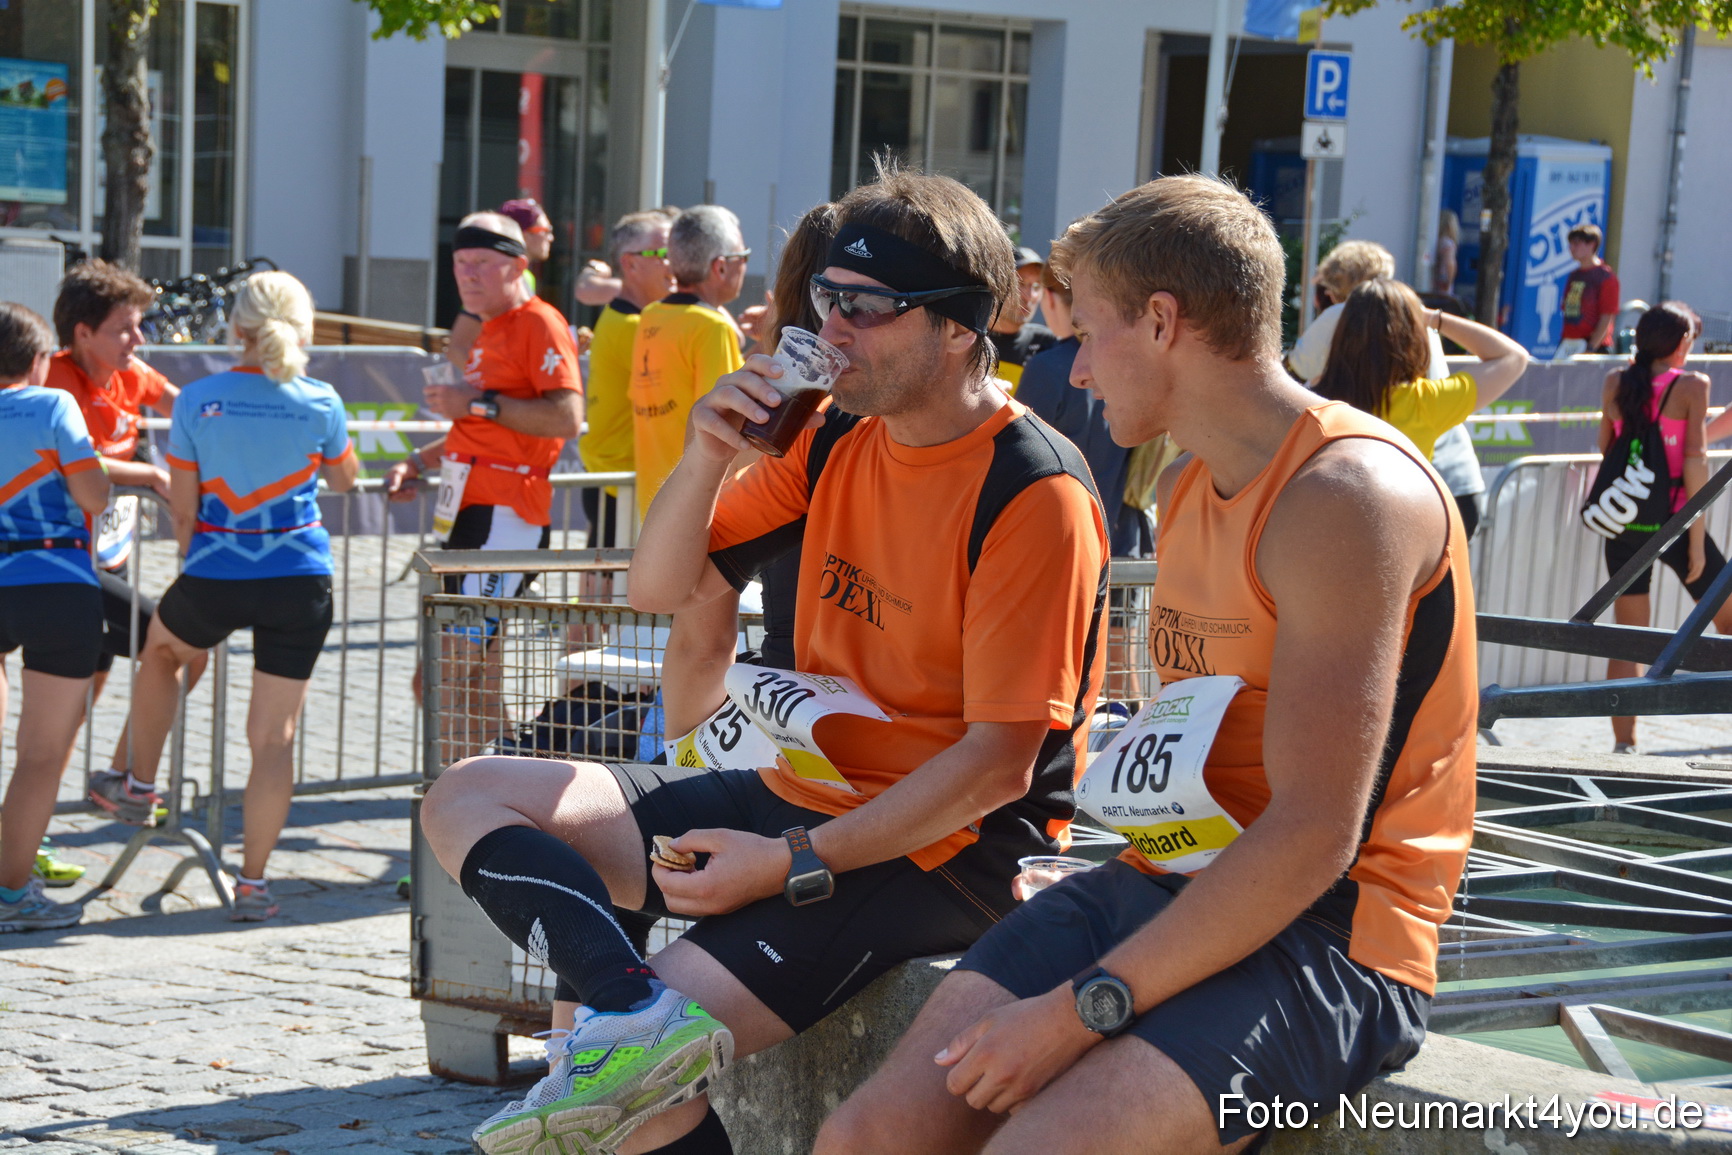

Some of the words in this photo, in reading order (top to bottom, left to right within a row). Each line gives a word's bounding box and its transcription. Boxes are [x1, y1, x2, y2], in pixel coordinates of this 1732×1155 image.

[1315, 60, 1342, 111] P
[1583, 459, 1656, 539] now
[823, 552, 863, 582] PTIK
[1152, 605, 1183, 629] OPTIK
[1209, 622, 1253, 634] SCHMUCK
[744, 672, 816, 729] 330
[1142, 696, 1195, 722] BOCK
[680, 748, 698, 769] Sil
[1111, 733, 1183, 794] 185
[1103, 806, 1129, 817] PARTL
[1129, 805, 1171, 818] Neumarkt
[1122, 825, 1198, 855] Richard
